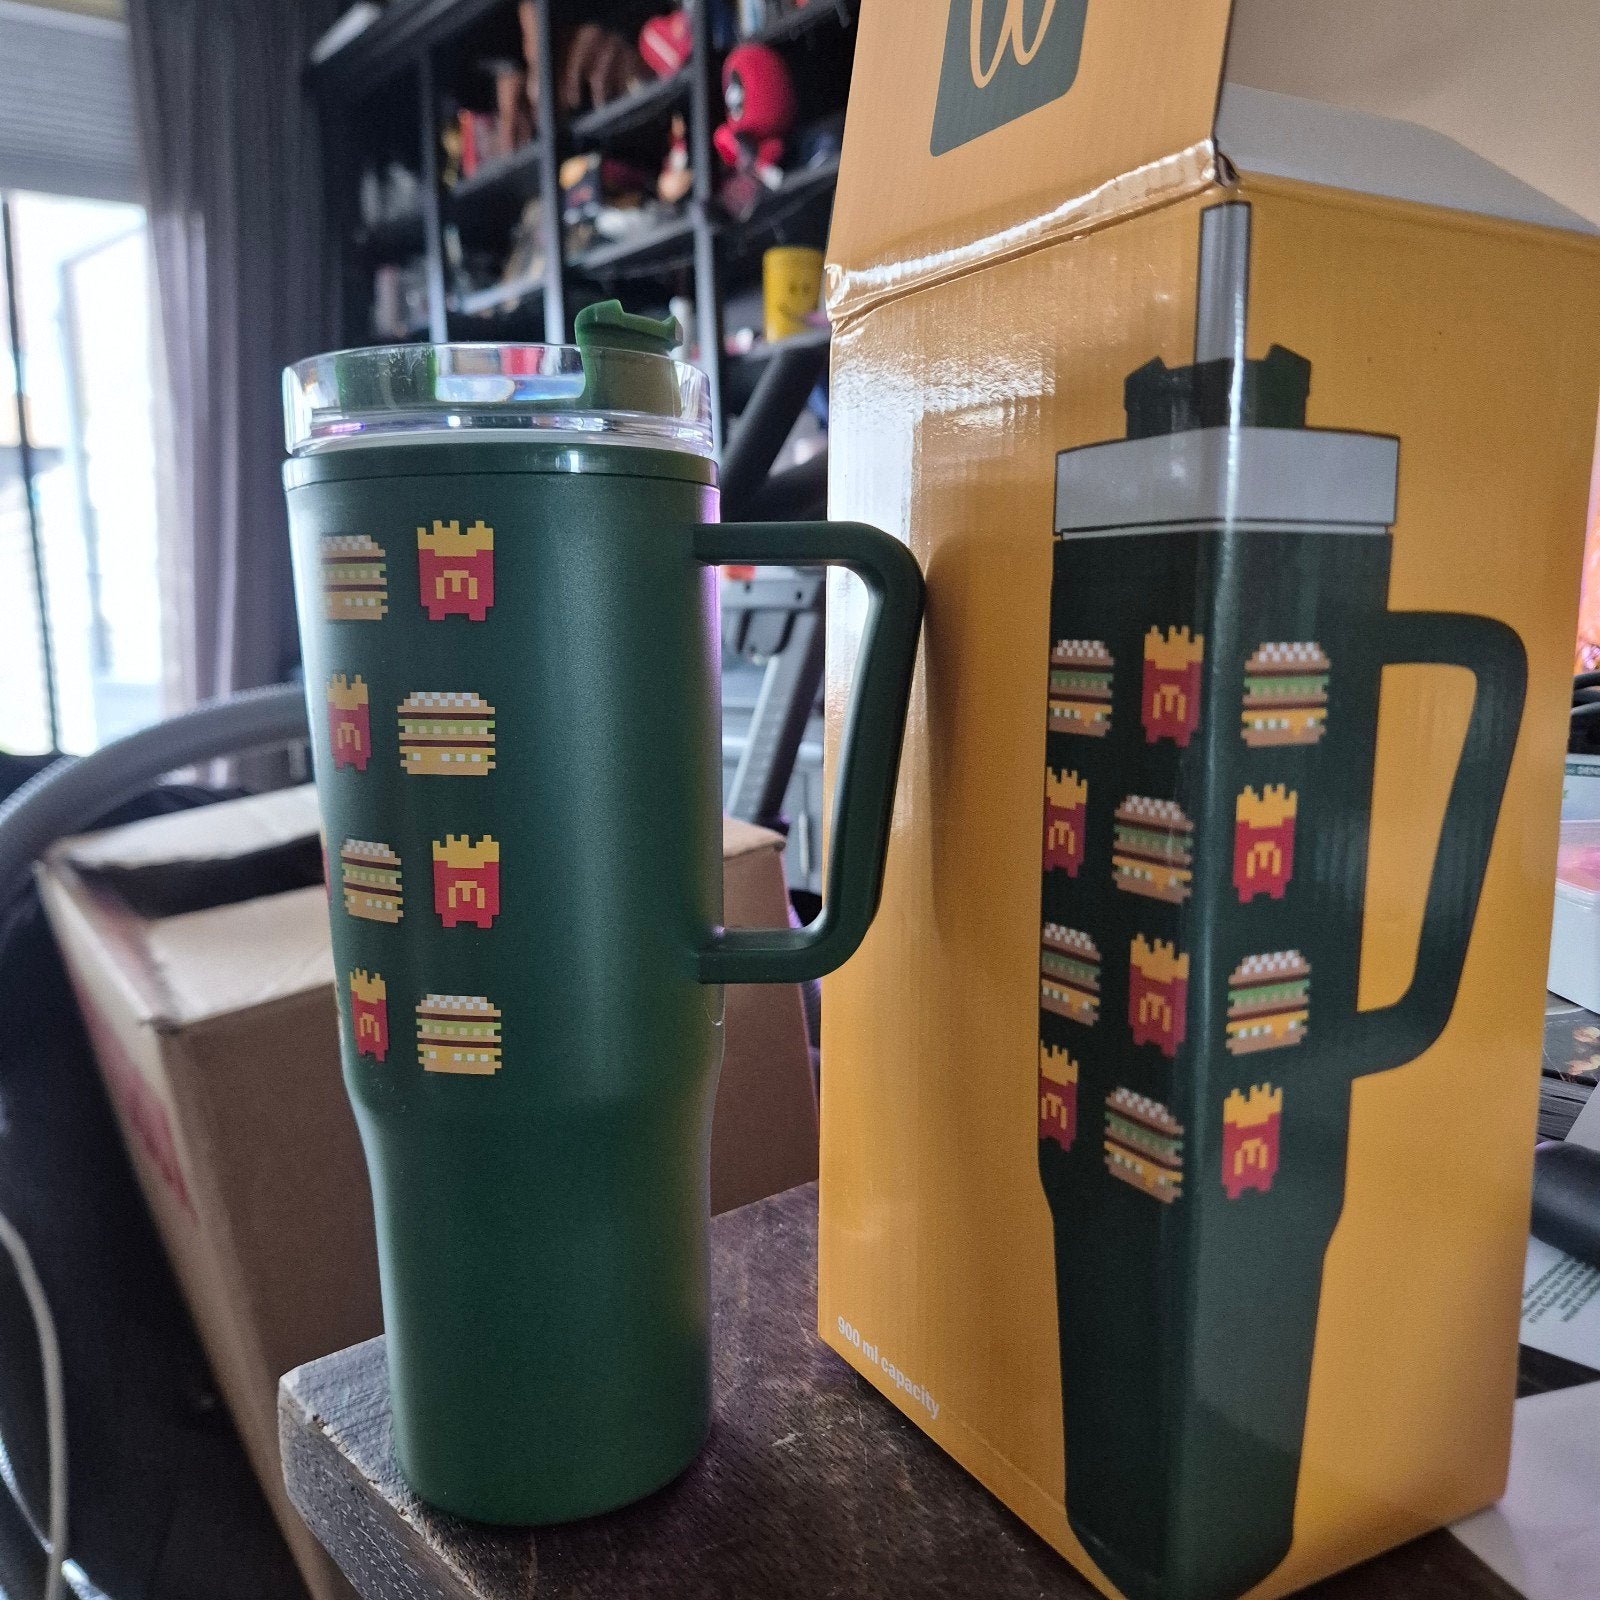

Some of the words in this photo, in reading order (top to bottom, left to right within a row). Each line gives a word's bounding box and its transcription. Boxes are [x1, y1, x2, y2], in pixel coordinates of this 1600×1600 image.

[837, 1313, 860, 1349] 900
[862, 1340, 879, 1365] ml
[880, 1356, 940, 1420] capacity
